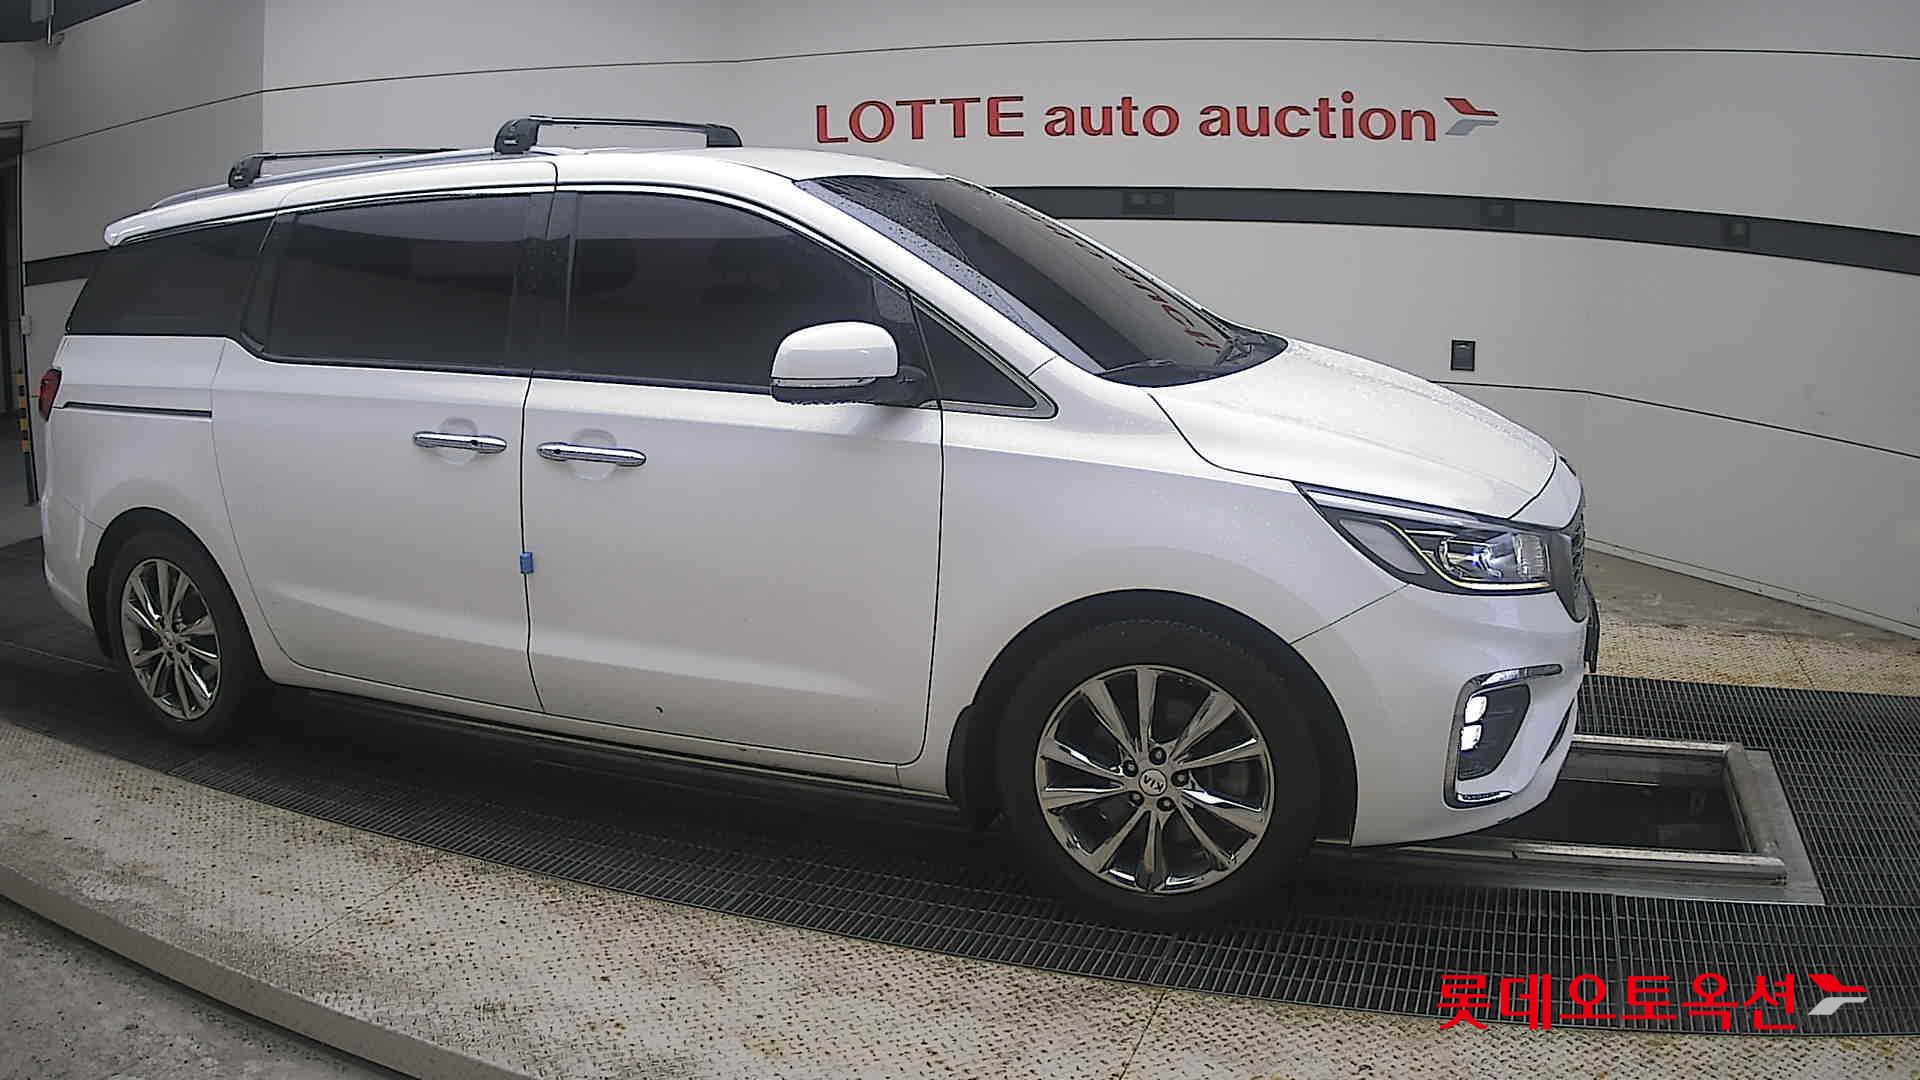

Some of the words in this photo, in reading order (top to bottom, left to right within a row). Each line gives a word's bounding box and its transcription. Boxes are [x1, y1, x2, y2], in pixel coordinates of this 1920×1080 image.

[815, 95, 1025, 144] LOTTE
[1043, 96, 1181, 138] auto
[1199, 91, 1438, 142] auction
